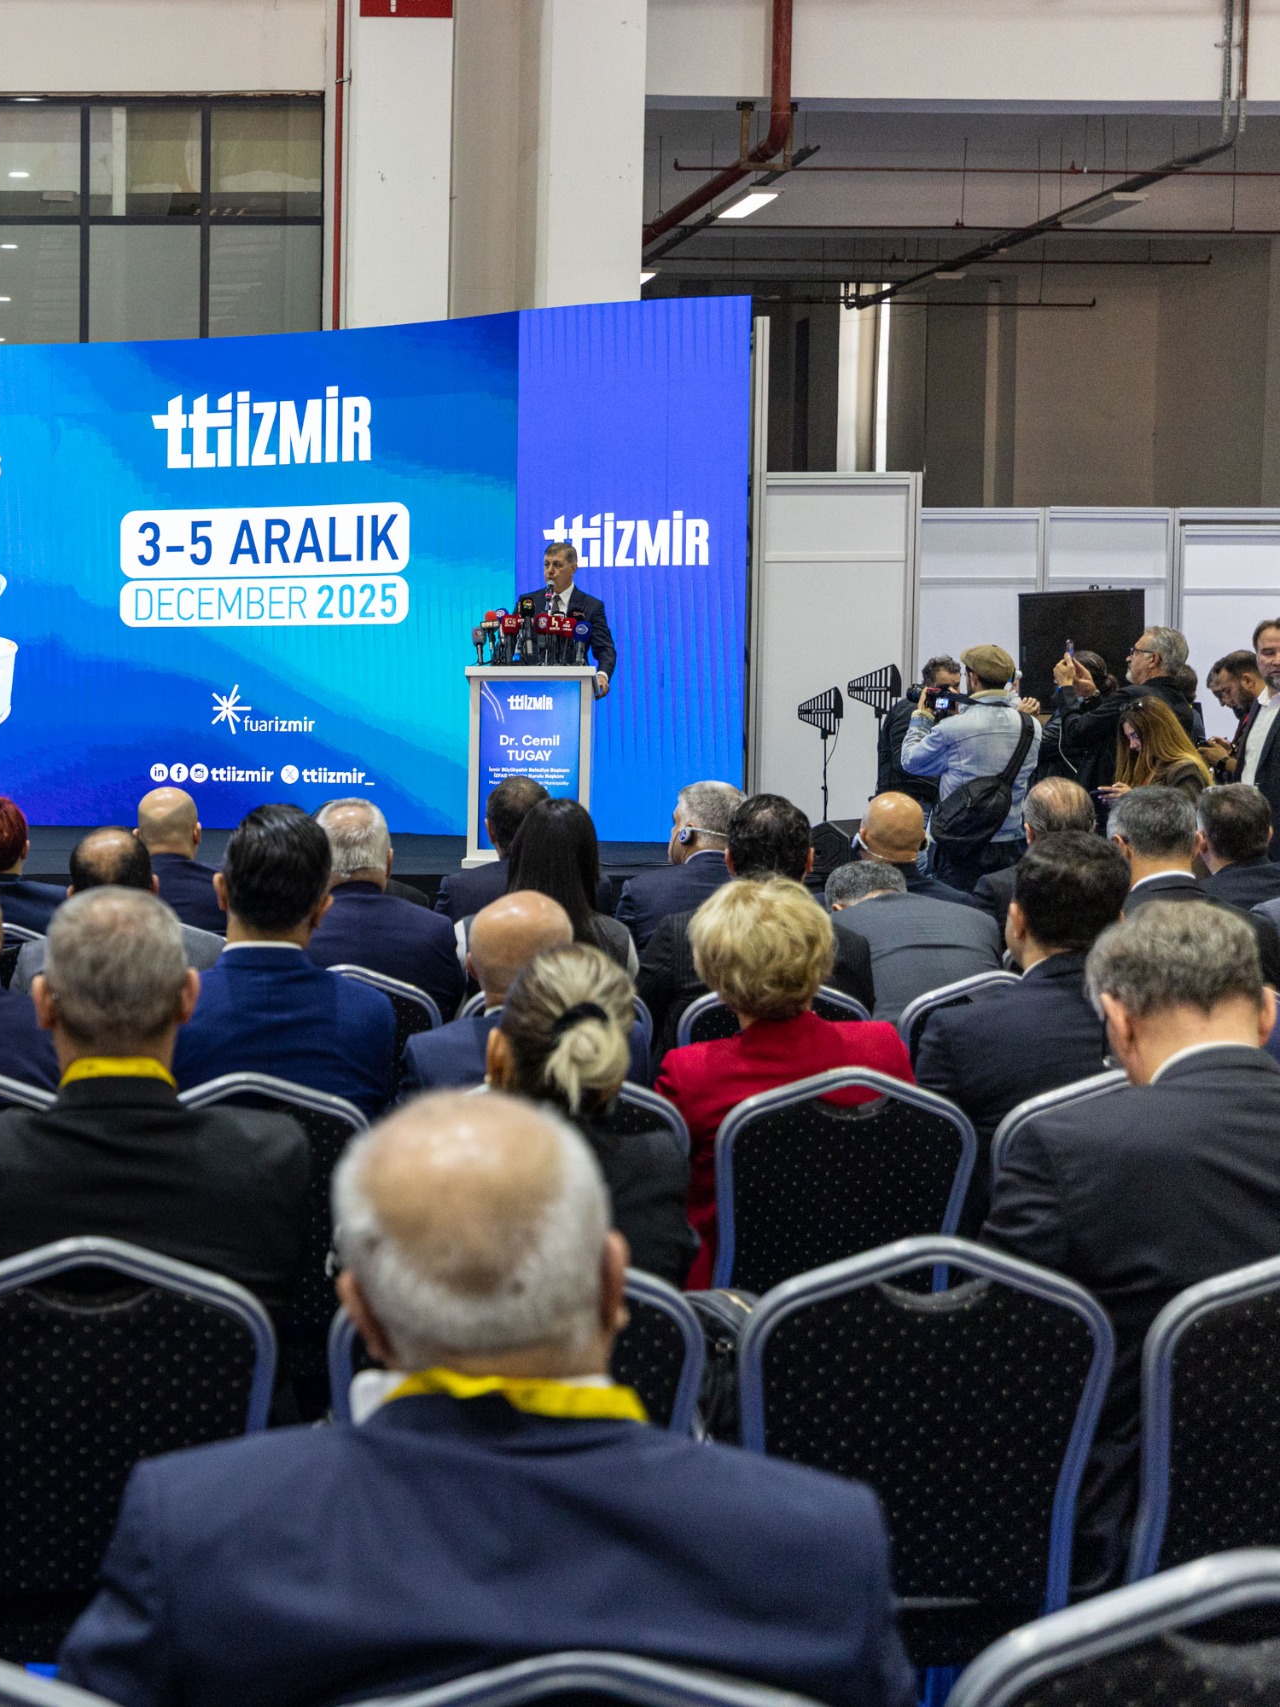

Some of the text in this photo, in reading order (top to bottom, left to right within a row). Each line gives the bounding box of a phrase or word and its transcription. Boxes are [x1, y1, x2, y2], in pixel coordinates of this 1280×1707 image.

[229, 514, 400, 565] ARALIK
[134, 582, 399, 621] DECEMBER 2025
[243, 716, 316, 732] fuarizmir
[499, 735, 560, 746] Dr. Cemil
[506, 750, 552, 762] TUGAY
[210, 766, 275, 783] ttiizmir
[302, 767, 375, 786] ttiizmir_
